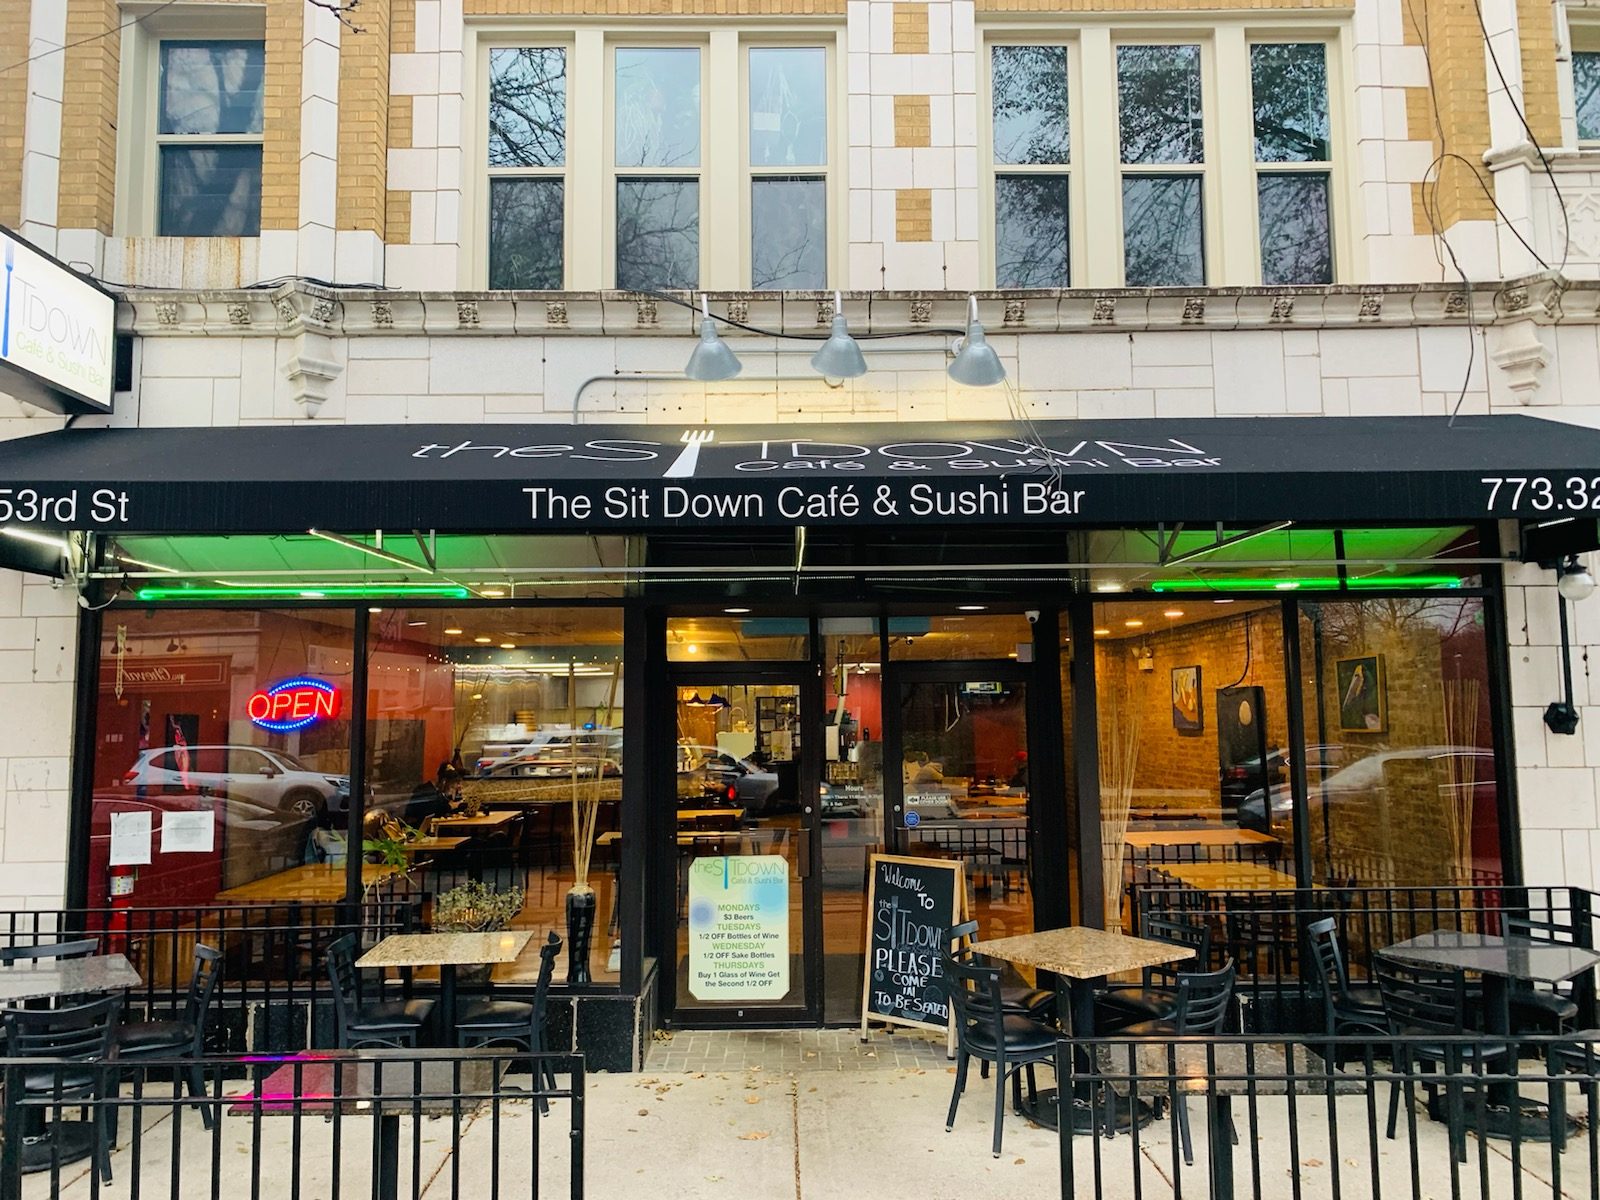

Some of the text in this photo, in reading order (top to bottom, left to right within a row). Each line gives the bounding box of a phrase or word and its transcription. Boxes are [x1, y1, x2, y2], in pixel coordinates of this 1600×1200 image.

[898, 459, 933, 471] &
[947, 456, 1110, 470] Sushi
[1124, 456, 1223, 469] Bar
[0, 488, 130, 523] 53rd St
[521, 483, 1086, 519] The Sit Down Café & Sushi Bar
[248, 690, 335, 720] OPEN
[844, 784, 864, 792] Hours
[880, 863, 926, 892] Welcome
[717, 903, 761, 912] MONDAYS
[723, 913, 733, 921] $3
[717, 923, 761, 931] TUESDAYS
[727, 932, 752, 940] Bottles
[712, 942, 766, 950] WEDNESDAY
[713, 961, 765, 969] THURSDAYS
[875, 947, 944, 978] PLEASE
[698, 971, 712, 980] Buy
[892, 973, 929, 988] COME
[902, 986, 916, 998] IN
[875, 990, 949, 1020] TO BE SEATED
